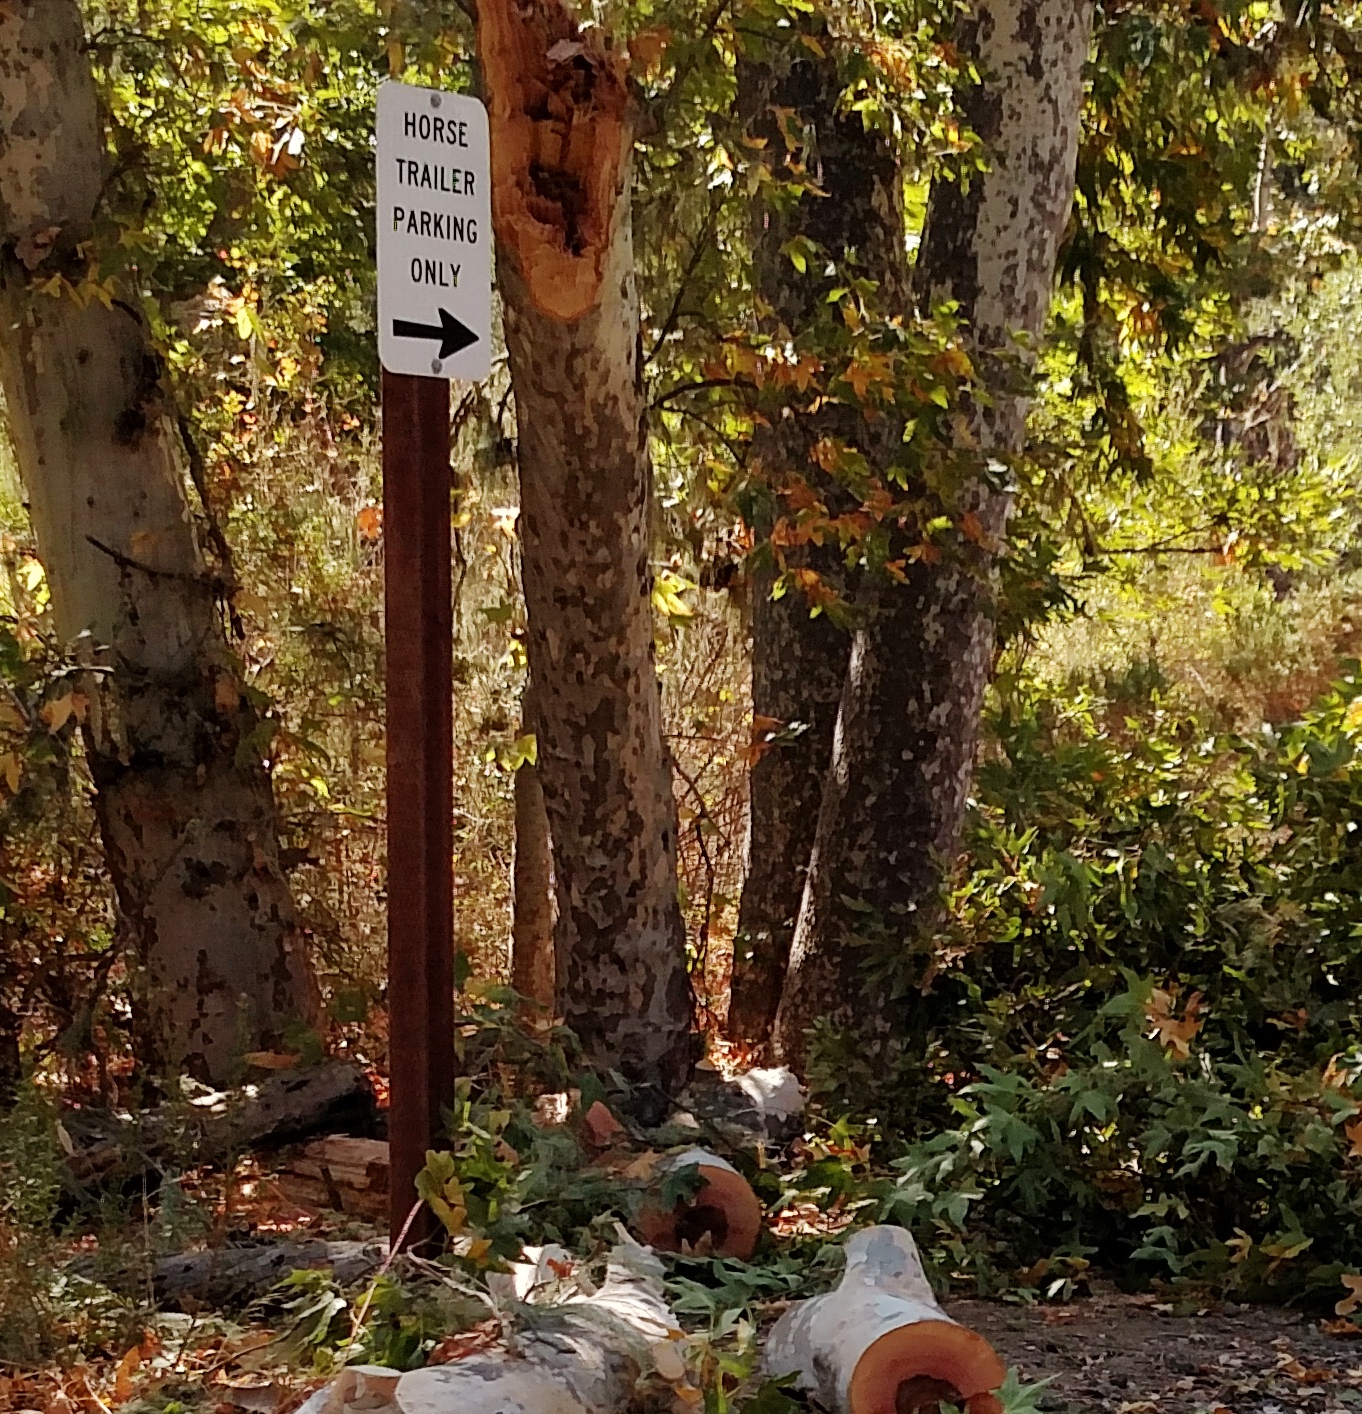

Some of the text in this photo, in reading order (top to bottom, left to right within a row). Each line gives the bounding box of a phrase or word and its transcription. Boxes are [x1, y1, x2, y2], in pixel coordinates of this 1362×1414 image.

[404, 112, 468, 147] HORSE
[396, 158, 475, 195] TRAILER
[394, 206, 477, 244] PARKING
[411, 258, 461, 287] ONLY
